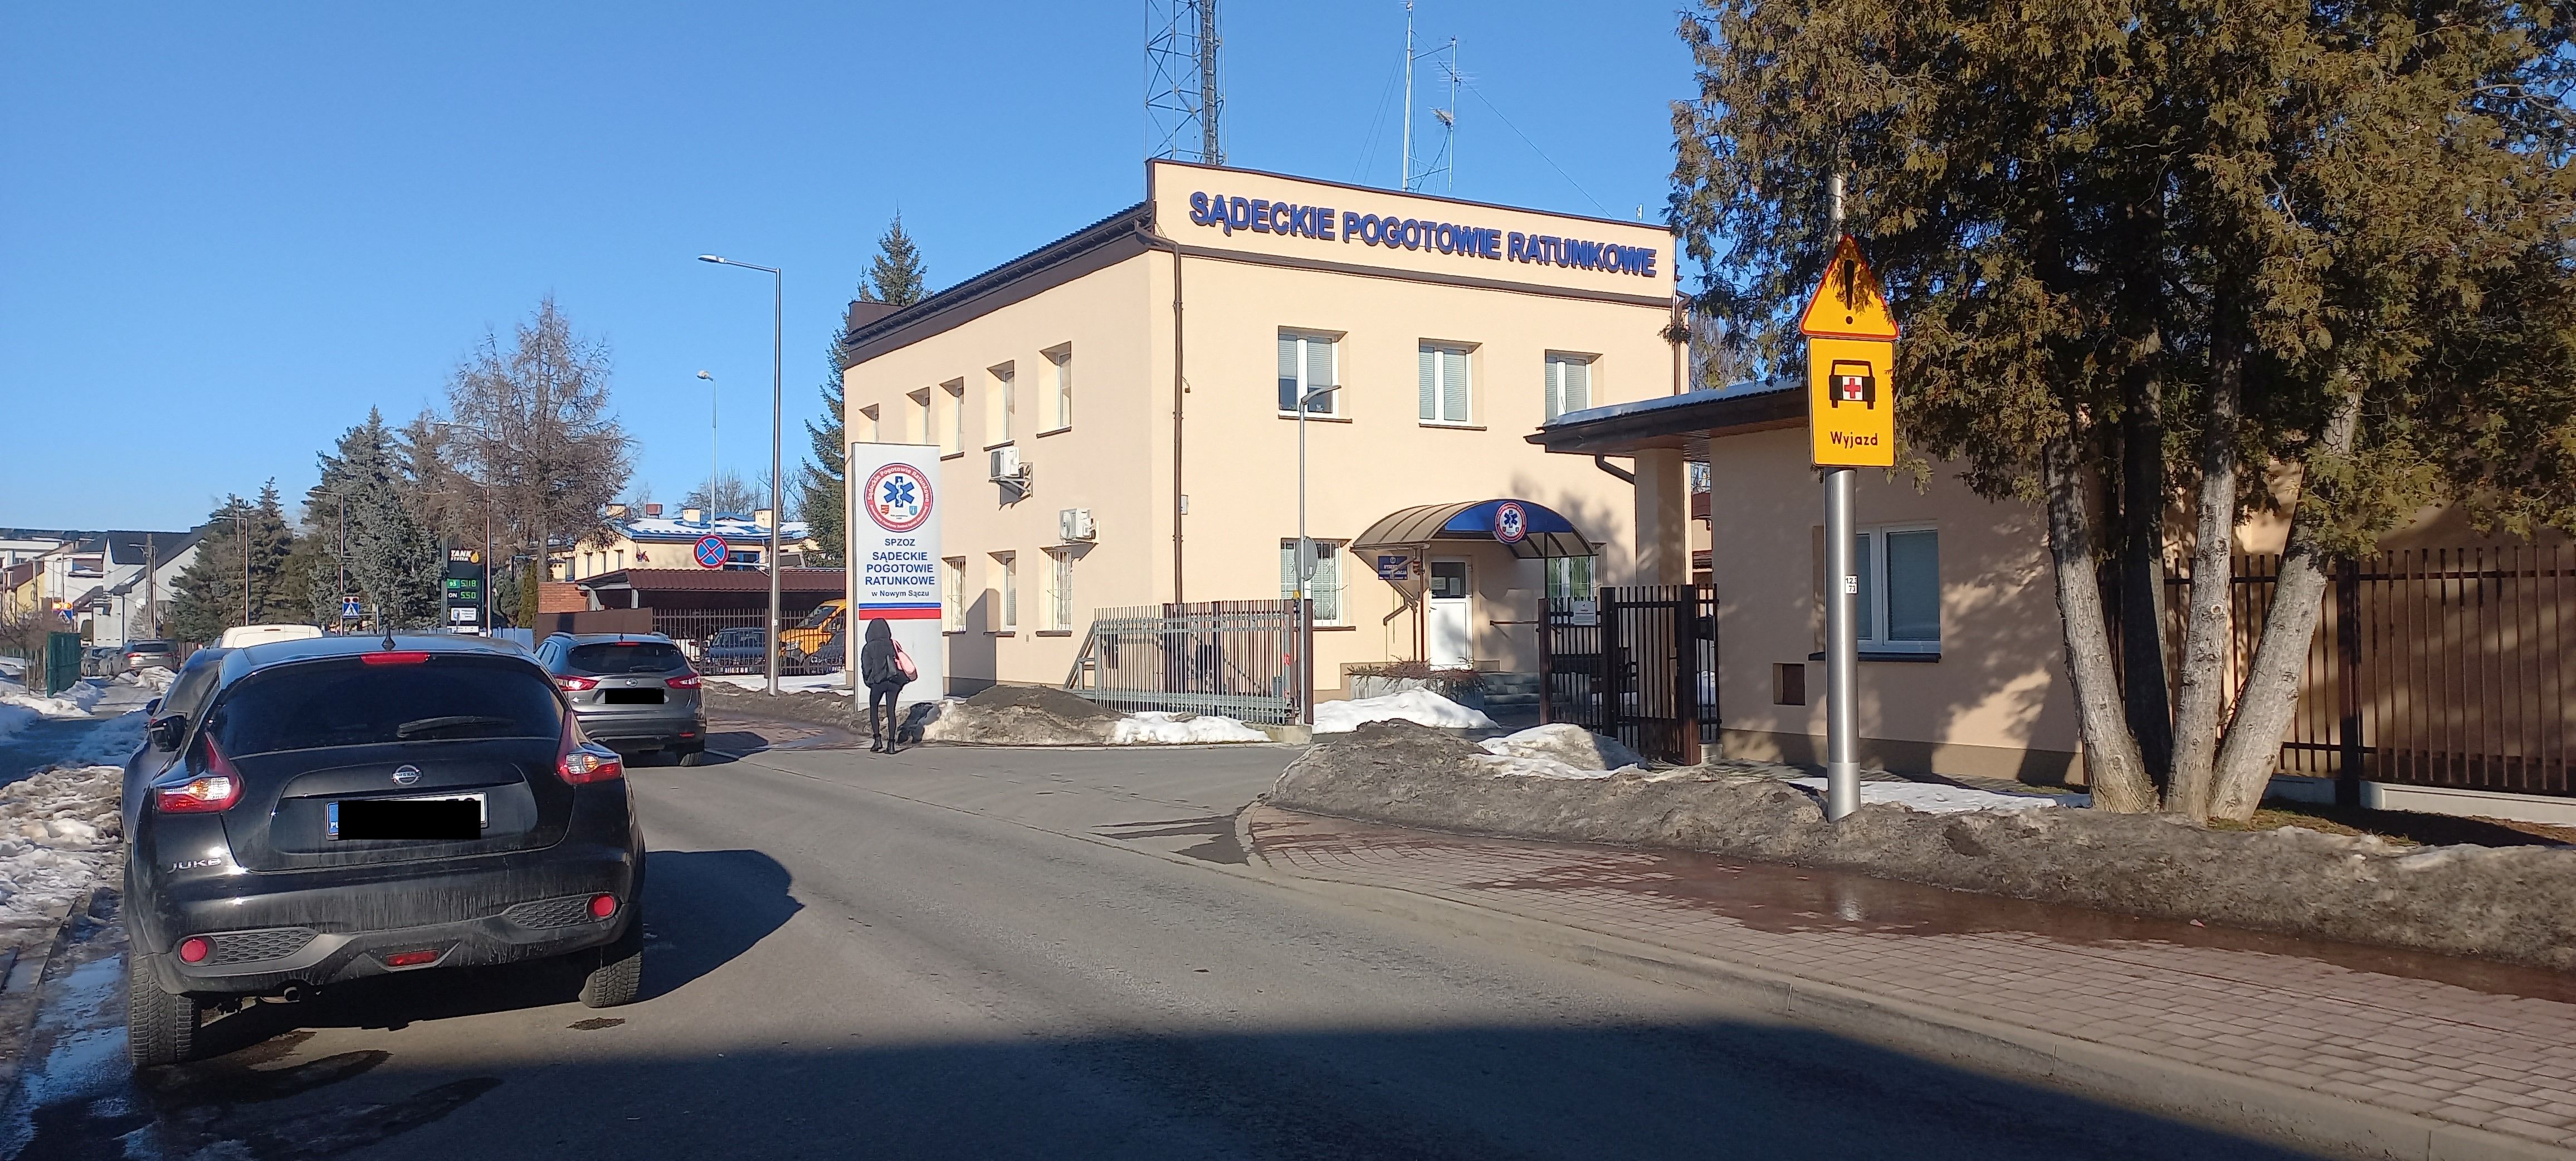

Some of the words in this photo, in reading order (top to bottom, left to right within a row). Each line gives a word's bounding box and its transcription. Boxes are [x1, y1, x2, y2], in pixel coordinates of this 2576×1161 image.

[1189, 192, 1335, 241] SĄDECKIE
[1343, 212, 1501, 260] POGOTOWIE
[1507, 232, 1657, 277] RATUNKOWE
[1830, 431, 1878, 448] Wyjazd
[872, 552, 928, 562] SĄDECKIE
[866, 564, 934, 573] POGOTOWIE
[865, 576, 935, 585] RATUNKOWE
